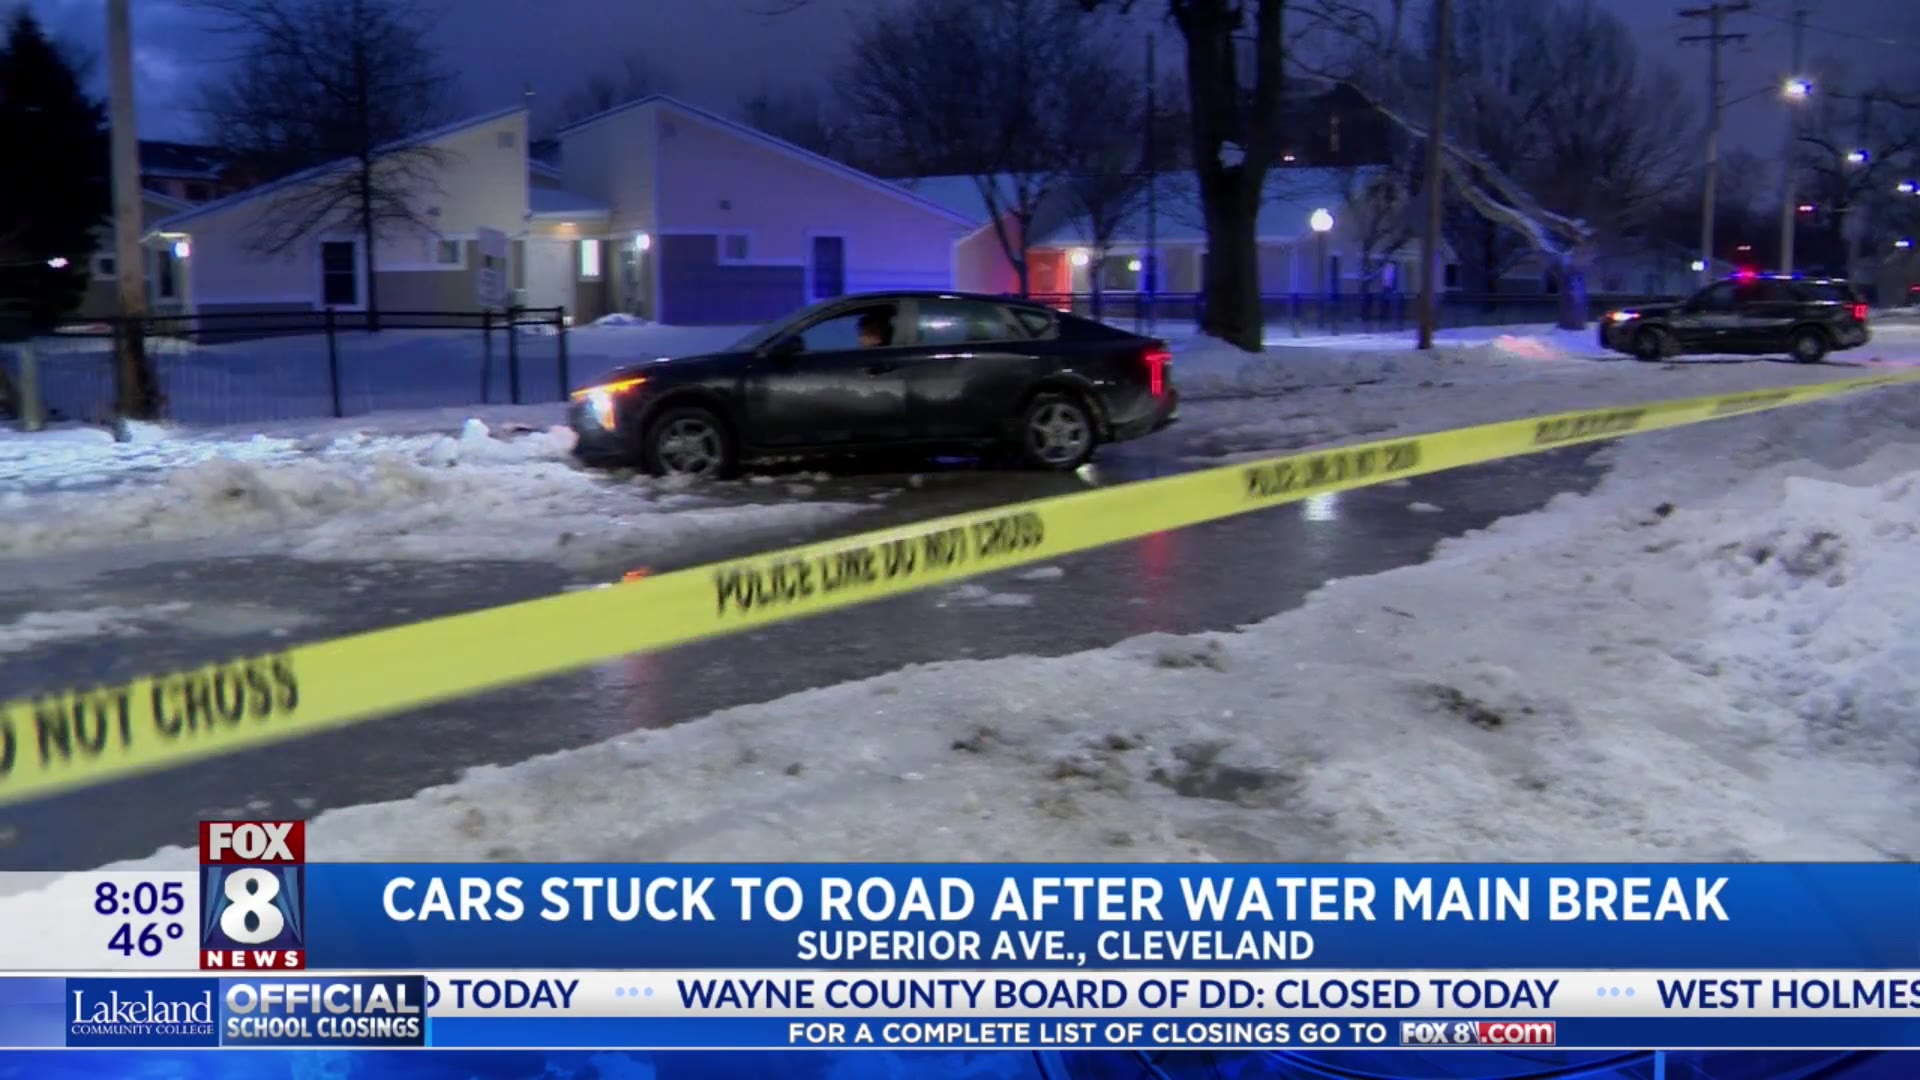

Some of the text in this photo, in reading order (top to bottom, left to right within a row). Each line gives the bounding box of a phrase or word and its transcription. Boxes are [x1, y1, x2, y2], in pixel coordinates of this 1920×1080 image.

[714, 556, 815, 616] POLICE
[820, 545, 879, 590] LINE
[36, 688, 132, 767] NOT
[152, 654, 299, 738] CROSS
